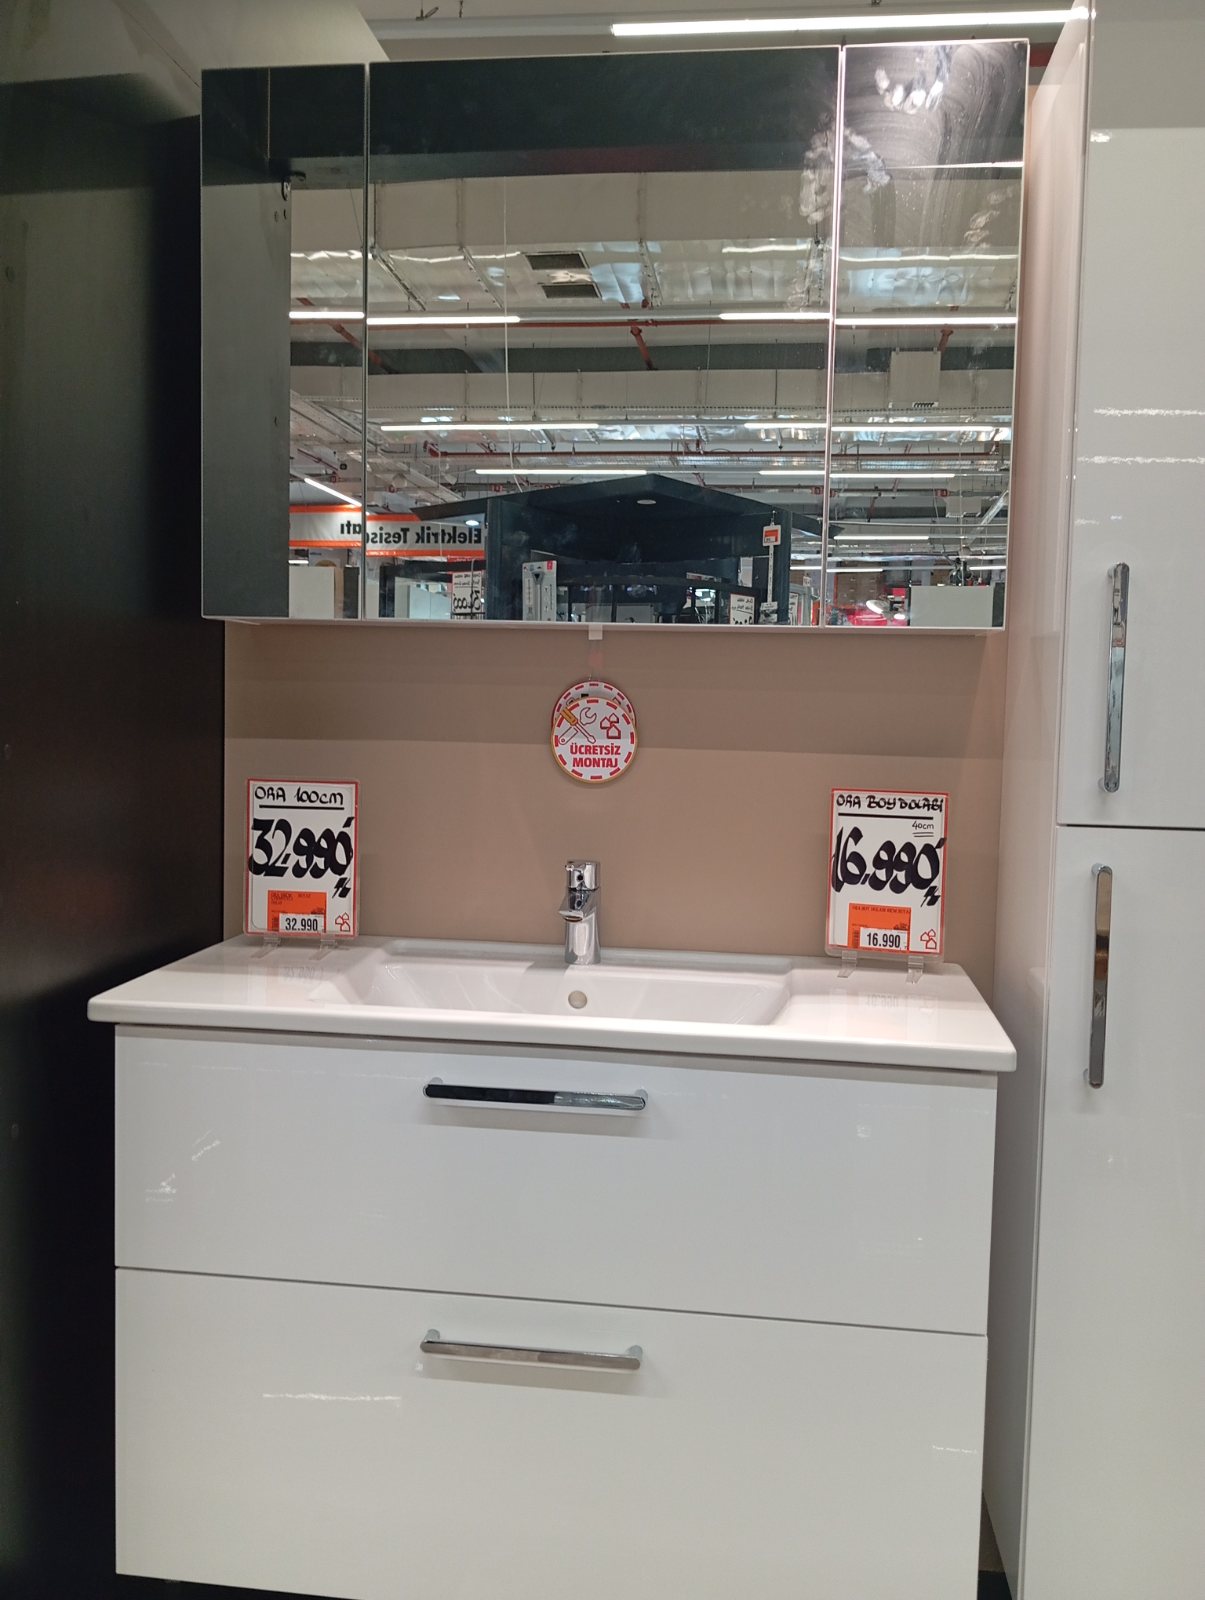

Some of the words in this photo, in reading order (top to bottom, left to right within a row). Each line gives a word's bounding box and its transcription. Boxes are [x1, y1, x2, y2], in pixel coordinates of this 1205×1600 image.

[570, 742, 621, 756] ÜCRETSİZ
[573, 757, 619, 768] MONTAJ
[254, 786, 286, 802] ORA
[836, 794, 861, 809] ORA
[866, 795, 897, 811] BOY
[911, 820, 935, 831] 40cm
[285, 917, 318, 932] 32.990
[866, 931, 901, 949] 16.990
